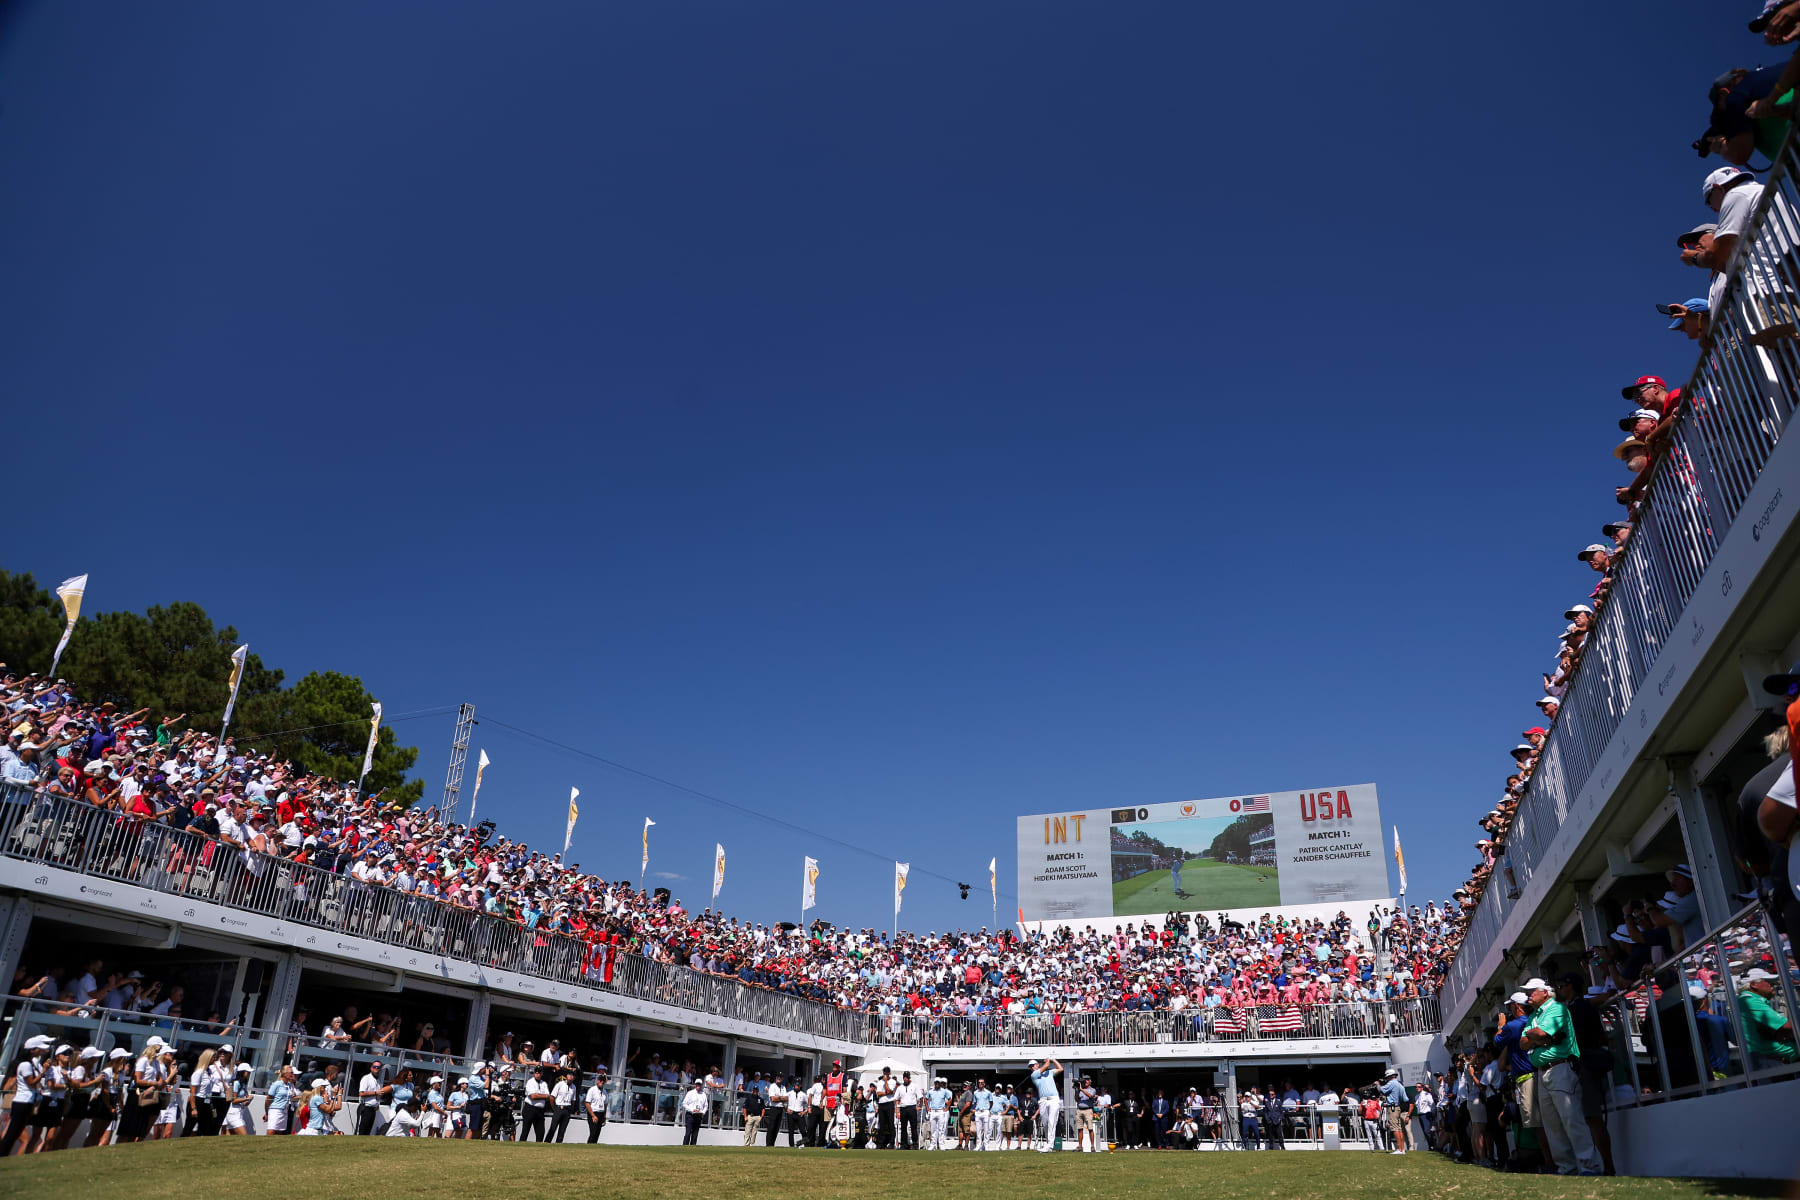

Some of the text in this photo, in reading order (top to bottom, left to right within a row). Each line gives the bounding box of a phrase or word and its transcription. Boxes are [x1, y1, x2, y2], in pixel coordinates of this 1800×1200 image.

[1300, 790, 1352, 822] USA
[1045, 814, 1086, 845] INT
[1308, 830, 1351, 840] MATCH 1:
[1298, 843, 1363, 854] PATRICK CANTLAY
[1046, 853, 1075, 861] MATCH
[1293, 850, 1371, 863] XANDER SCHAUFFELE
[1045, 866, 1065, 874] ADAM
[34, 876, 48, 885] citi
[1056, 871, 1098, 881] MATSUYAMA
[183, 908, 195, 917] citi
